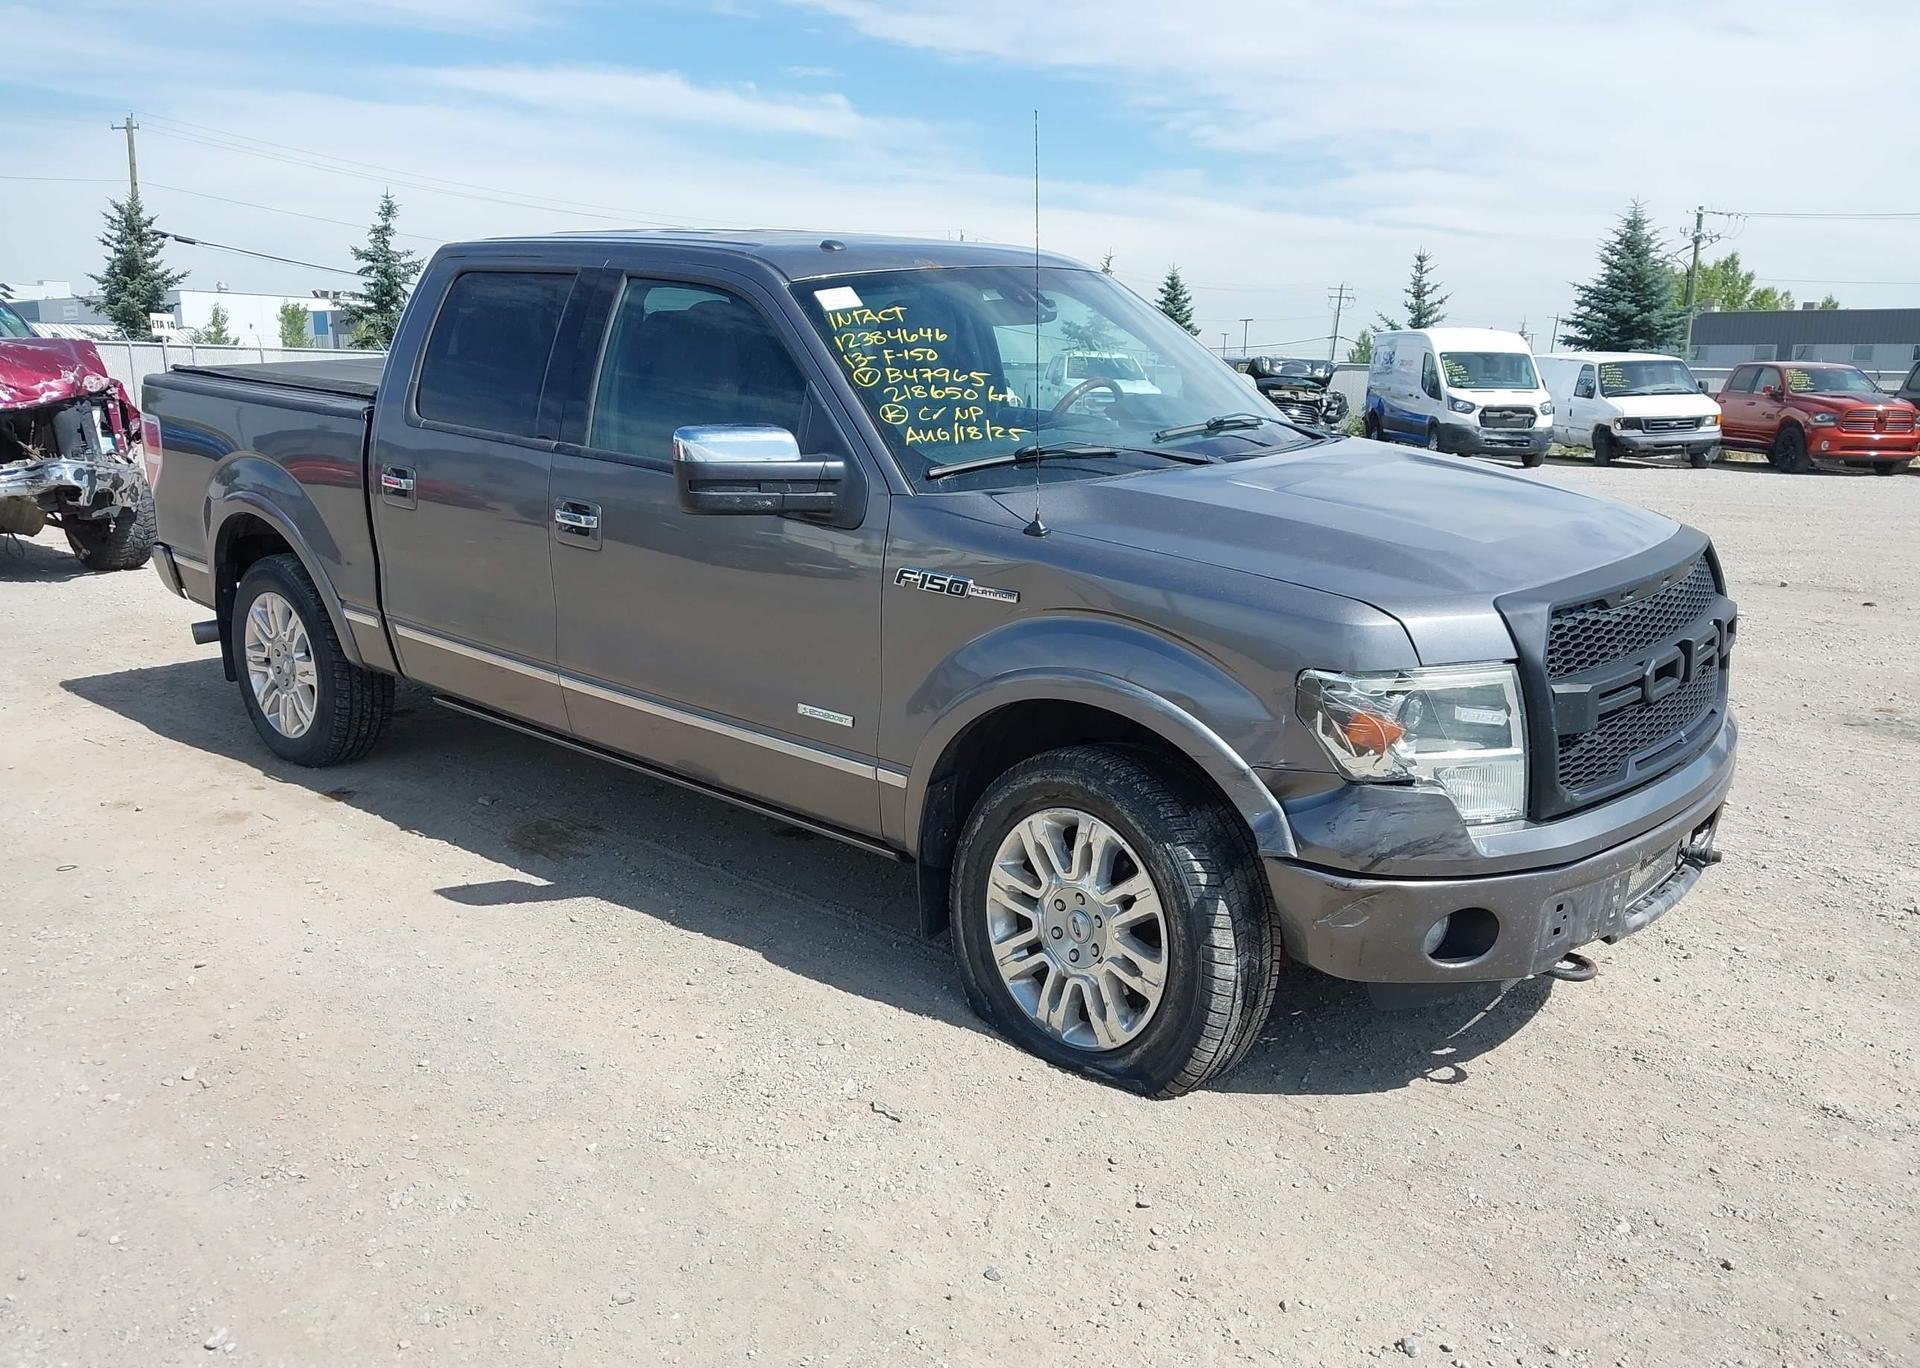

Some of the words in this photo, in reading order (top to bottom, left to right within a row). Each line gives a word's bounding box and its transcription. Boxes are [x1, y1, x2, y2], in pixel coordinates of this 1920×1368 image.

[829, 306, 907, 330] INTACT
[834, 327, 948, 353] 12384646
[883, 348, 939, 366] F-150
[885, 367, 992, 388] B47965
[883, 384, 979, 402] 218650
[954, 406, 984, 422] NP
[893, 567, 974, 599] F-150
[970, 587, 1018, 601] PLATINUM
